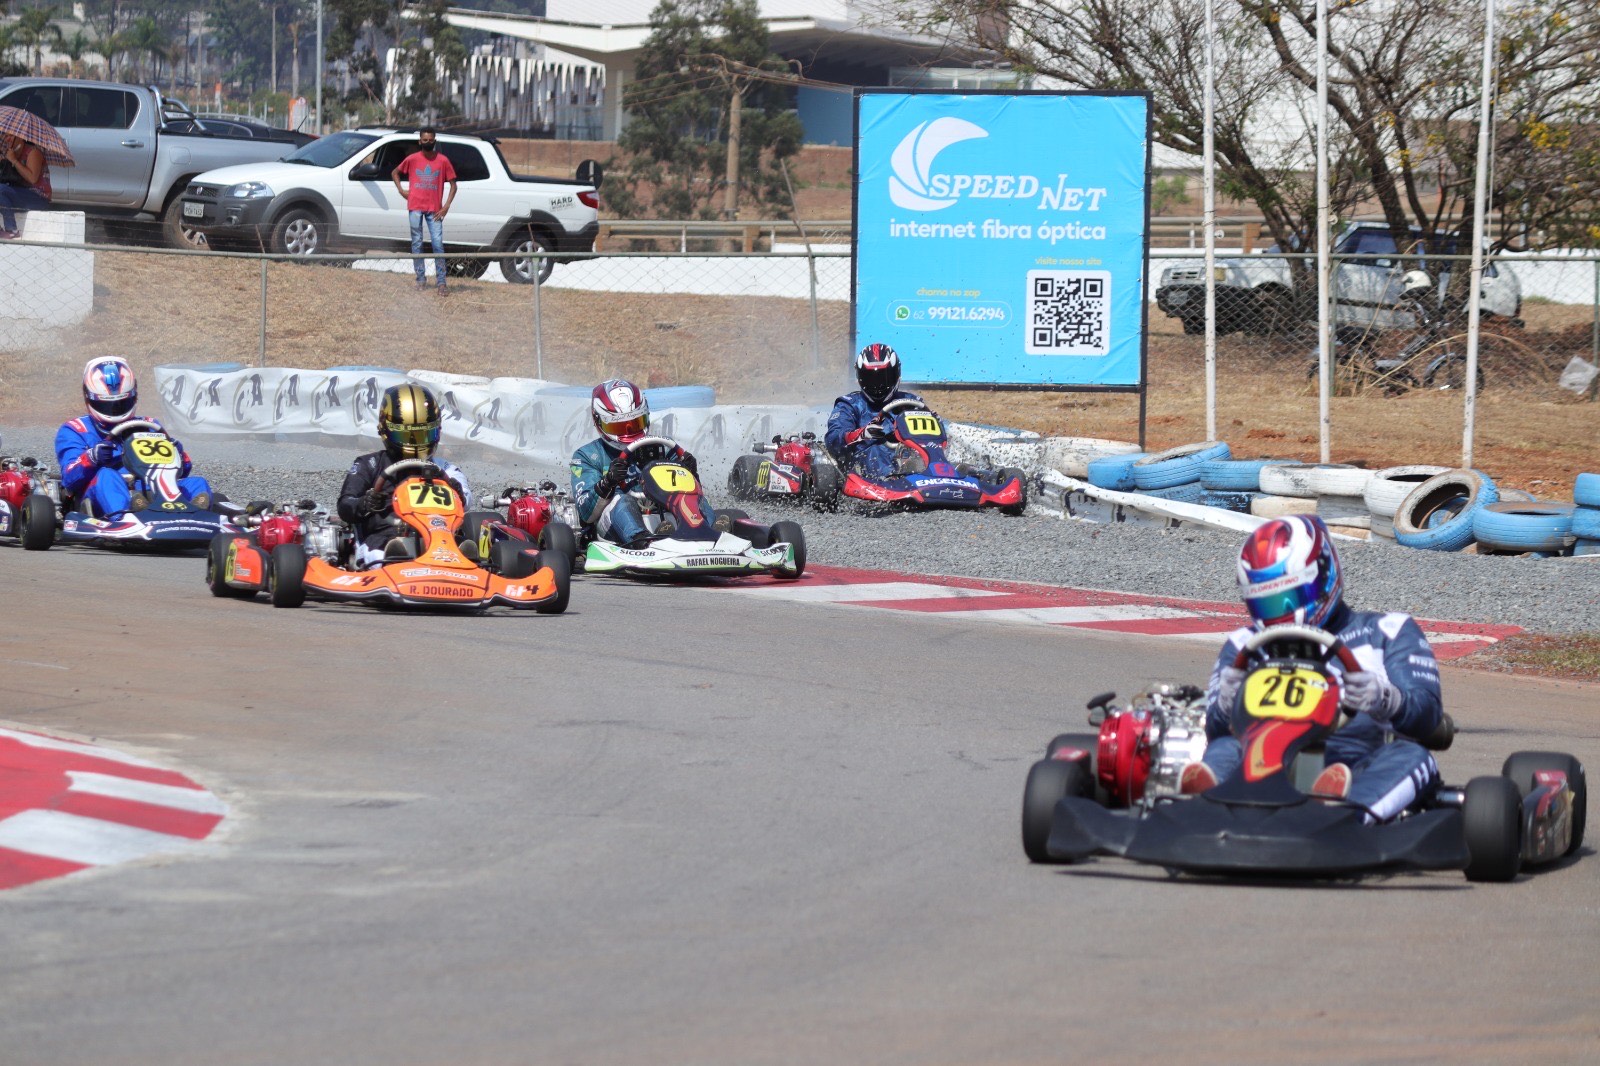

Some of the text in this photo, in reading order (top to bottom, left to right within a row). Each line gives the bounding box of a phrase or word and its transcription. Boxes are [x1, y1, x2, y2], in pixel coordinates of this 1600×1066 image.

[928, 173, 1107, 211] SPEED NET
[551, 196, 573, 206] HARD
[889, 218, 1107, 245] internet fibra óptica
[950, 289, 962, 297] no
[912, 306, 1006, 321] 62 99121.6294
[908, 418, 936, 431] 777
[136, 439, 173, 457] 36
[666, 469, 677, 486] 7
[915, 478, 979, 490] ENGECOM
[410, 485, 452, 506] 79
[619, 549, 656, 557] SICOOB
[686, 557, 740, 567] RAFAEL NOGUEIRA
[409, 585, 474, 597] R. DOURADO
[1258, 675, 1308, 708] 26
